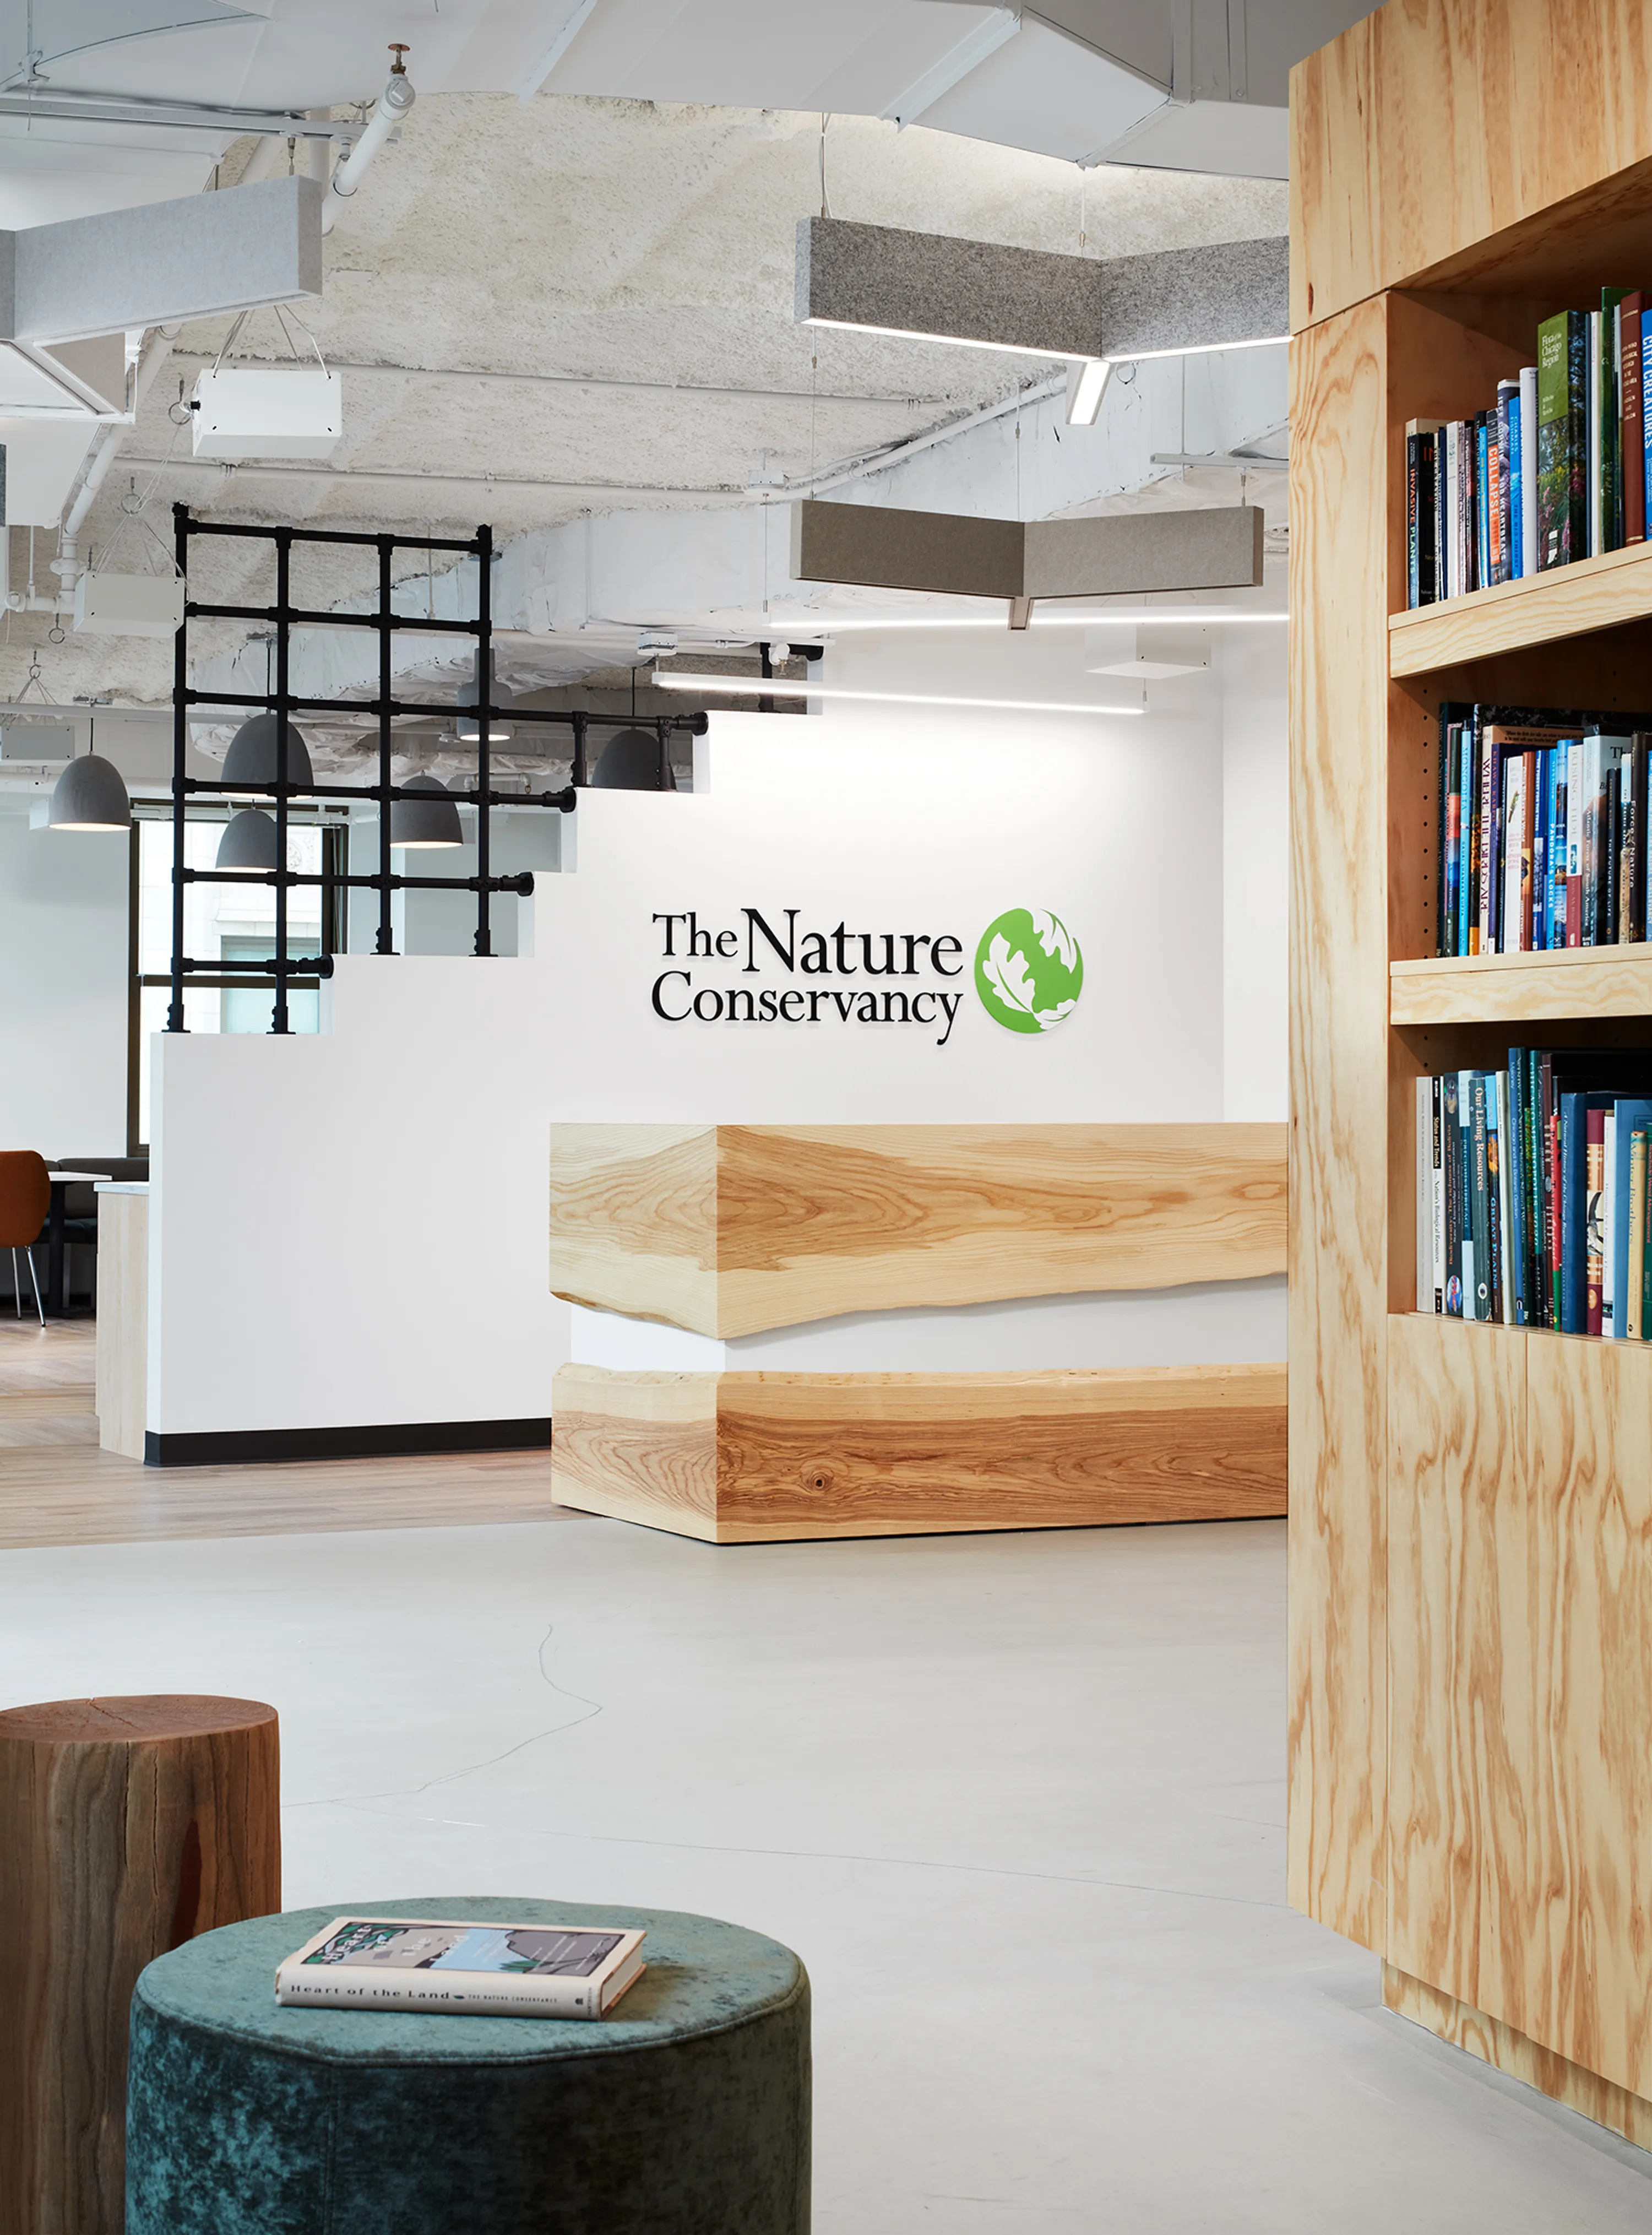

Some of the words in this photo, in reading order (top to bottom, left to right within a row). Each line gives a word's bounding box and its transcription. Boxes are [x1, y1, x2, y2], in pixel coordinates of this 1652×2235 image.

[1643, 334, 1652, 366] CITY
[1644, 370, 1652, 449] CREATURES
[1488, 447, 1499, 517] COLLAPSE
[1482, 757, 1491, 809] WHERE
[1571, 751, 1579, 801] RISING
[1607, 888, 1612, 898] OF
[653, 912, 738, 958] The
[740, 908, 964, 976] Nature
[651, 970, 964, 1045] Conservancy
[1475, 1087, 1484, 1108] Our
[1473, 1109, 1483, 1142] Living
[1475, 1143, 1485, 1191] Resources
[322, 1924, 373, 1962] Heart
[373, 1938, 393, 1952] of
[400, 1936, 432, 1956] the
[428, 1935, 470, 1962] Land
[290, 1984, 340, 1995] Heart
[347, 1987, 365, 1996] of
[372, 1989, 401, 1998] the
[408, 1990, 450, 2000] Land
[511, 1996, 558, 2004] CONSERVANCY
